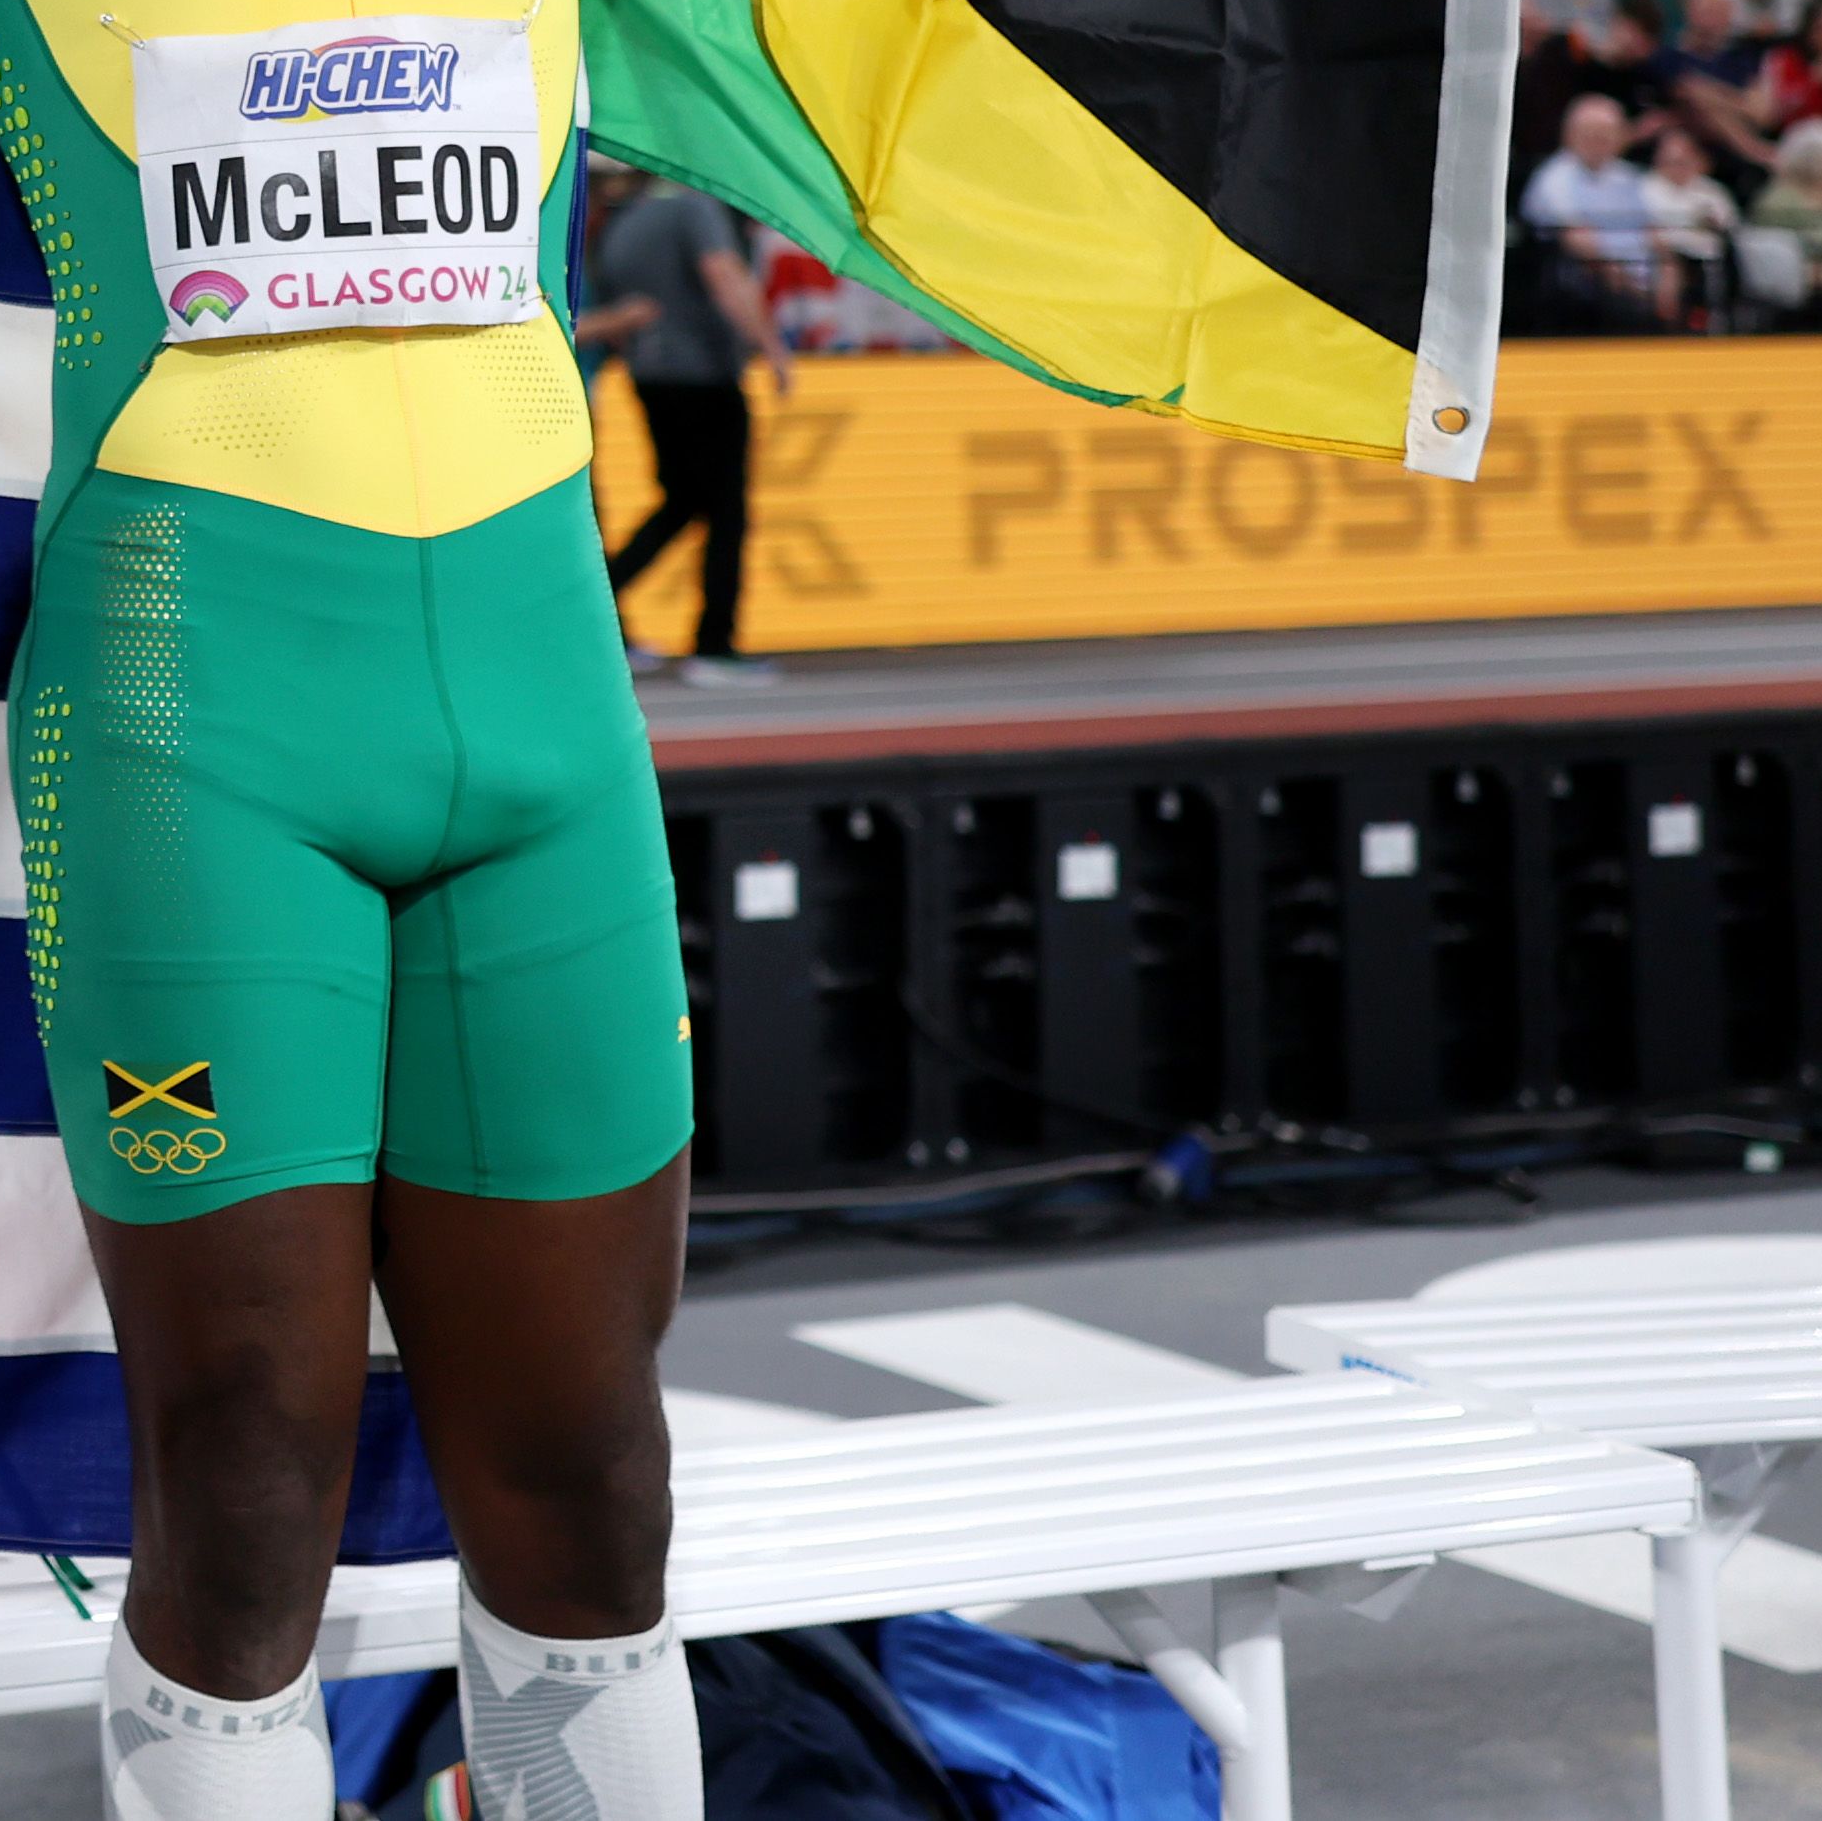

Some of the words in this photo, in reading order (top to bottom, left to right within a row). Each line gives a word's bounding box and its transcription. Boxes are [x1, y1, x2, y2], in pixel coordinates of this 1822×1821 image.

[240, 42, 459, 120] HI-CHEW
[171, 143, 519, 251] McLEOD
[267, 265, 491, 309] GLASGOW
[498, 265, 527, 301] 24
[969, 412, 1772, 566] PROSPEX
